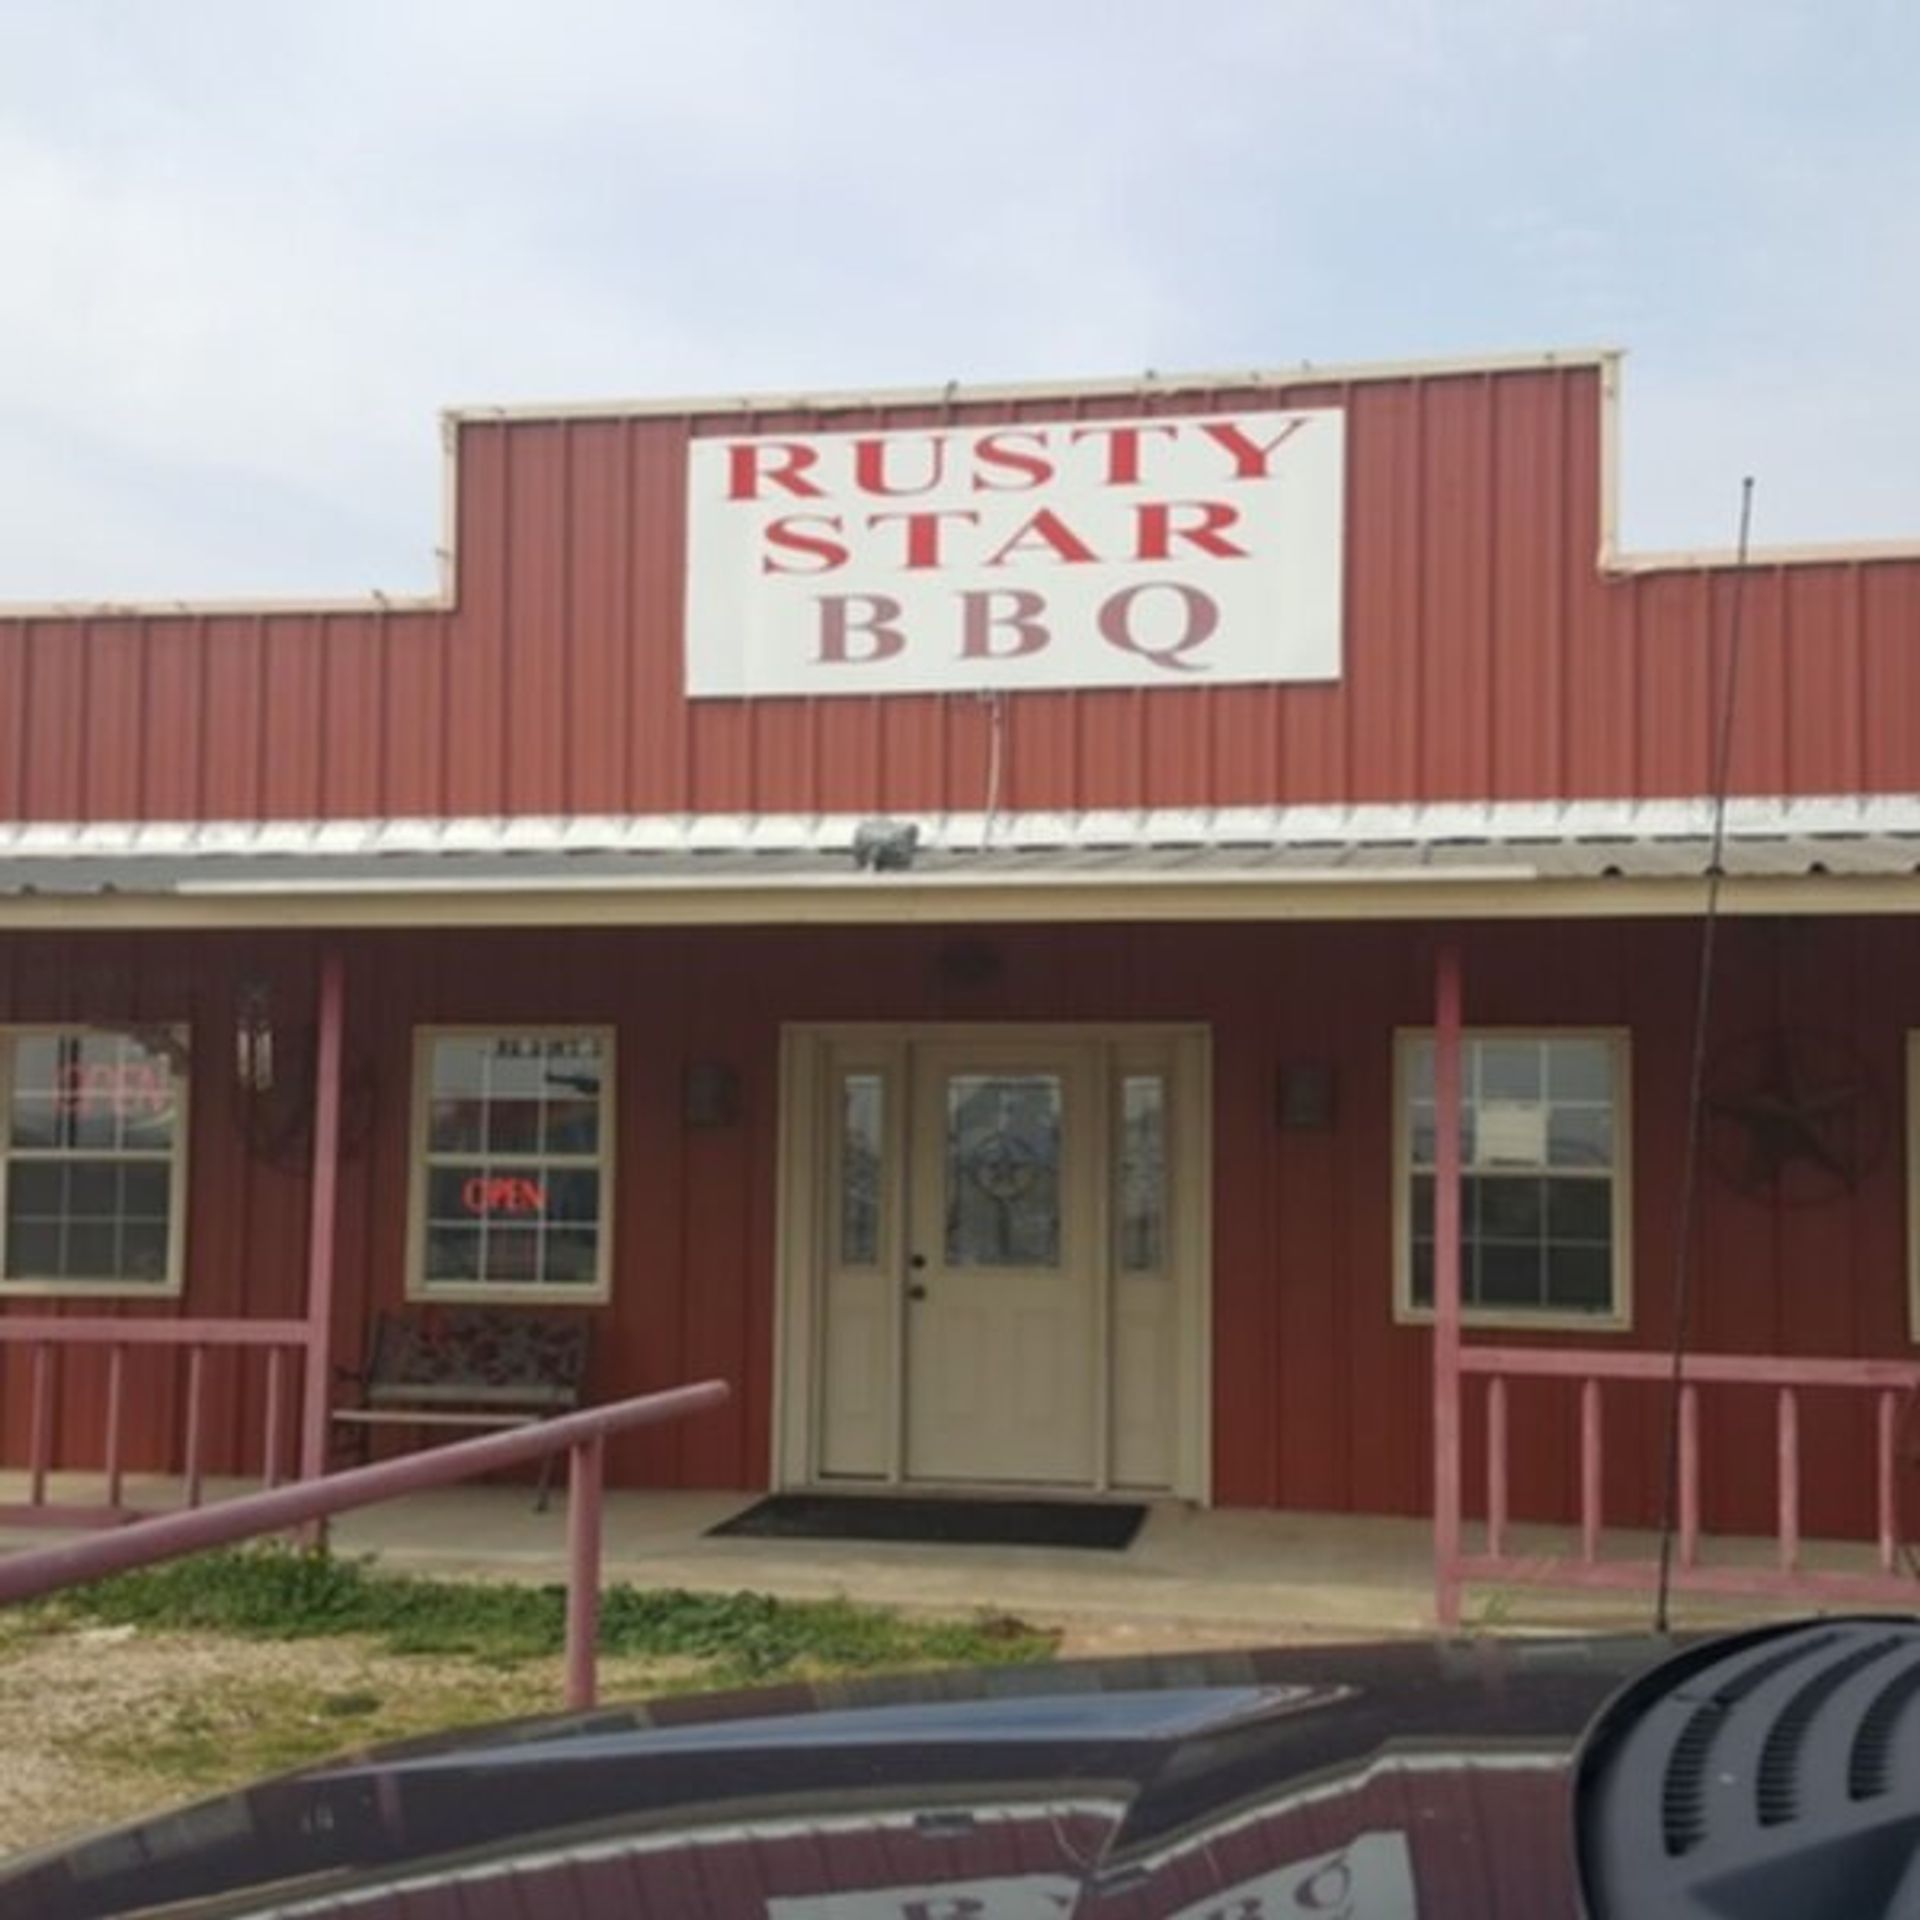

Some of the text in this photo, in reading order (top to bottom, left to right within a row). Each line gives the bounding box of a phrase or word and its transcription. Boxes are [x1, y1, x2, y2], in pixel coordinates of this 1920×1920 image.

[726, 416, 1312, 501] RUSTY
[762, 501, 1250, 575] STAR
[462, 1177, 547, 1213] OPEN
